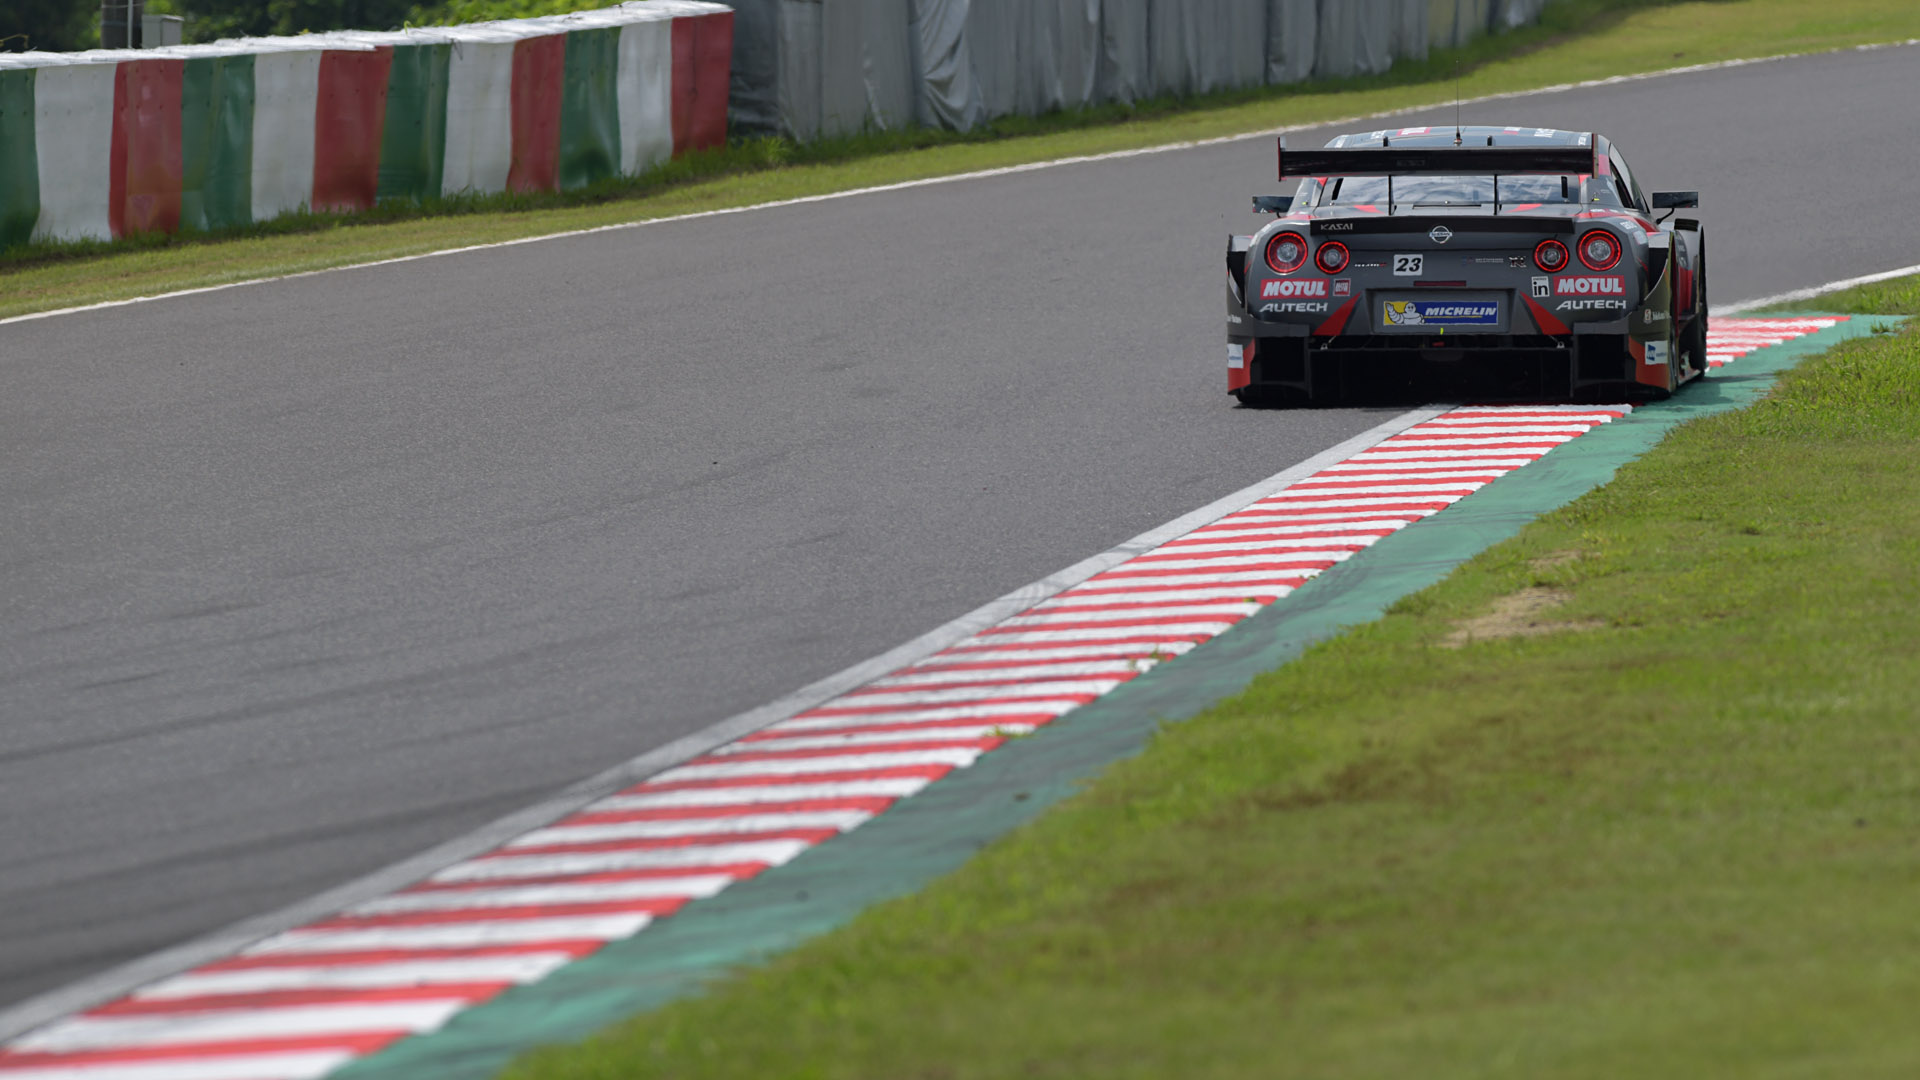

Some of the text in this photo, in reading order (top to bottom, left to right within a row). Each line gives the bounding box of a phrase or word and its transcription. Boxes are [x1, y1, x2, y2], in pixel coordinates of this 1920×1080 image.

[1396, 258, 1421, 272] 23
[1263, 281, 1326, 296] MOTUL
[1533, 281, 1548, 296] in
[1557, 278, 1622, 293] MOTUL
[1260, 303, 1328, 312] AUTECH
[1425, 307, 1496, 316] MICHELIN
[1556, 300, 1626, 310] AUTECH
